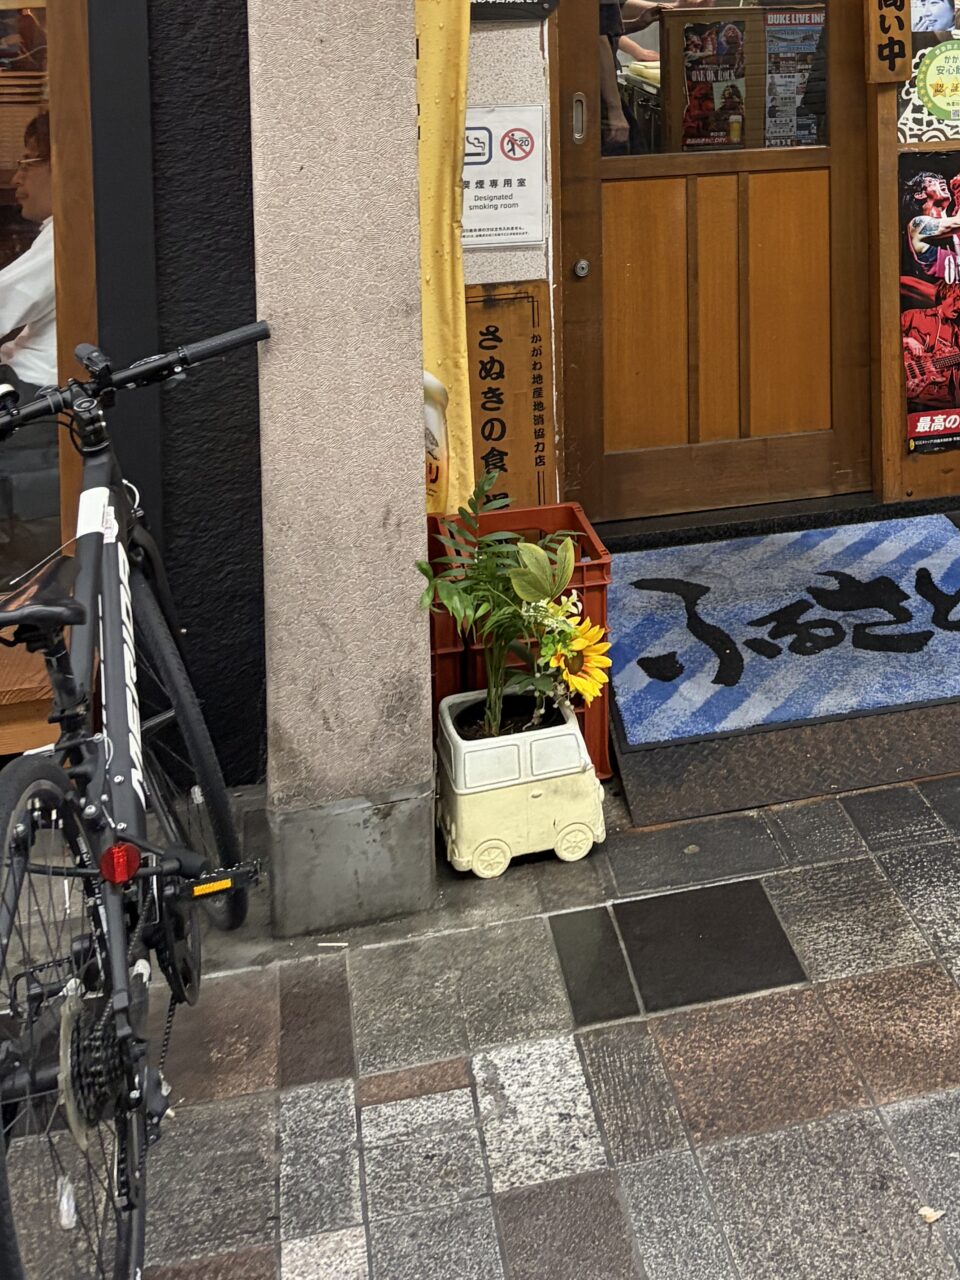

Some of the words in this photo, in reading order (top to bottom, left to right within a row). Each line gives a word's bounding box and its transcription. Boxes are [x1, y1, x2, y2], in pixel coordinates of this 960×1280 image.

[767, 14, 791, 24] DUKE
[792, 14, 811, 24] LIVE
[473, 193, 514, 202] Designated
[468, 203, 499, 211] smoking
[500, 202, 519, 210] room
[530, 332, 546, 468] かがわ地産地消協力店
[118, 541, 148, 812] MERIDA
